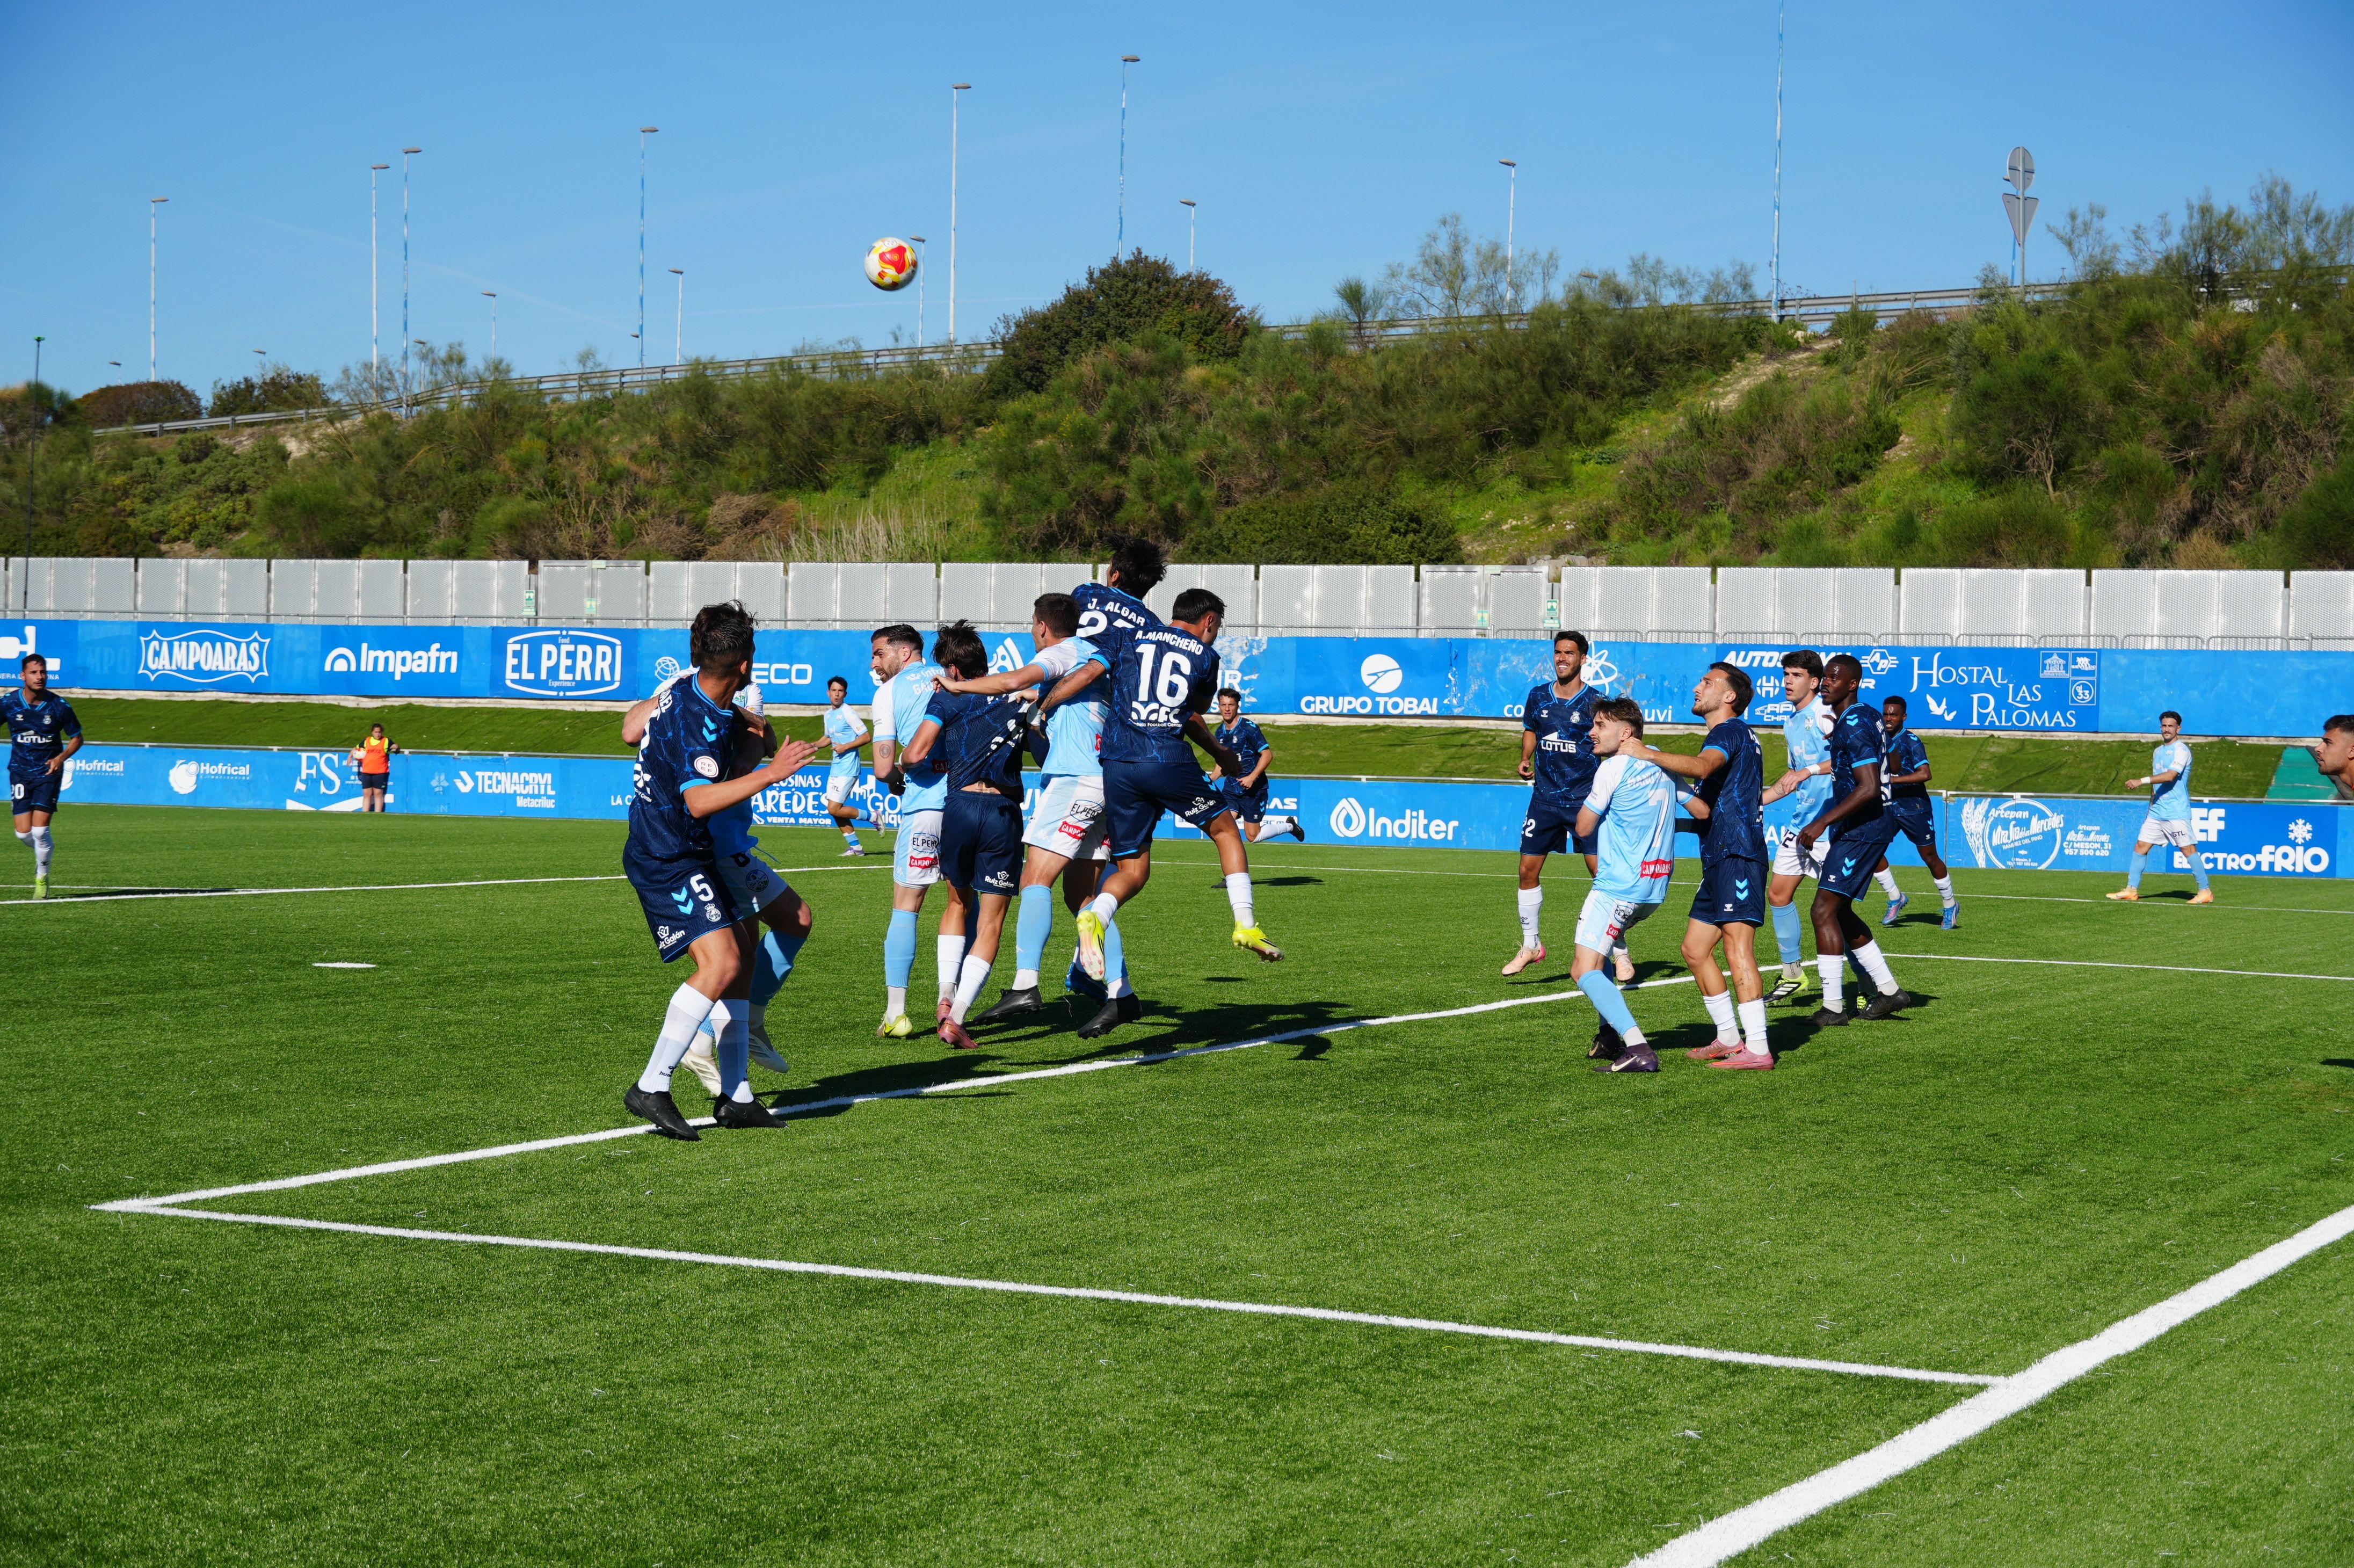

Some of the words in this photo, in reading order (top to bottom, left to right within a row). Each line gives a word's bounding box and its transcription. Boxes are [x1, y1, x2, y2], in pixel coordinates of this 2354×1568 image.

[1087, 598, 1100, 610] J.
[1105, 601, 1145, 627] ALGAR
[1135, 630, 1203, 655] A.MANCHEÑO
[147, 640, 260, 672] CAMPOARAS
[360, 643, 458, 681] Impafri
[505, 643, 535, 680] EL
[548, 679, 576, 687] Experience
[1135, 644, 1191, 707] 16
[1300, 695, 1372, 714] GRUPO
[2007, 684, 2041, 708] LAS
[1970, 693, 2076, 728] PALOMAS
[1541, 739, 1576, 753] LOTUS
[76, 759, 125, 772] Hofrical
[200, 762, 250, 775] Hofrical
[475, 771, 556, 795] TECNACRYL
[516, 795, 556, 809] Metacriluc
[611, 794, 623, 805] LA
[799, 816, 832, 825] MAYOR
[1369, 807, 1459, 840] Inditer
[1648, 788, 1669, 847] 7
[1988, 808, 2029, 819] Artepan
[2030, 814, 2064, 835] Mercedes
[913, 837, 920, 847] EL
[690, 874, 714, 902] 5
[985, 875, 998, 885] Ruiz
[998, 879, 1014, 888] Galán
[664, 930, 686, 945] Galán
